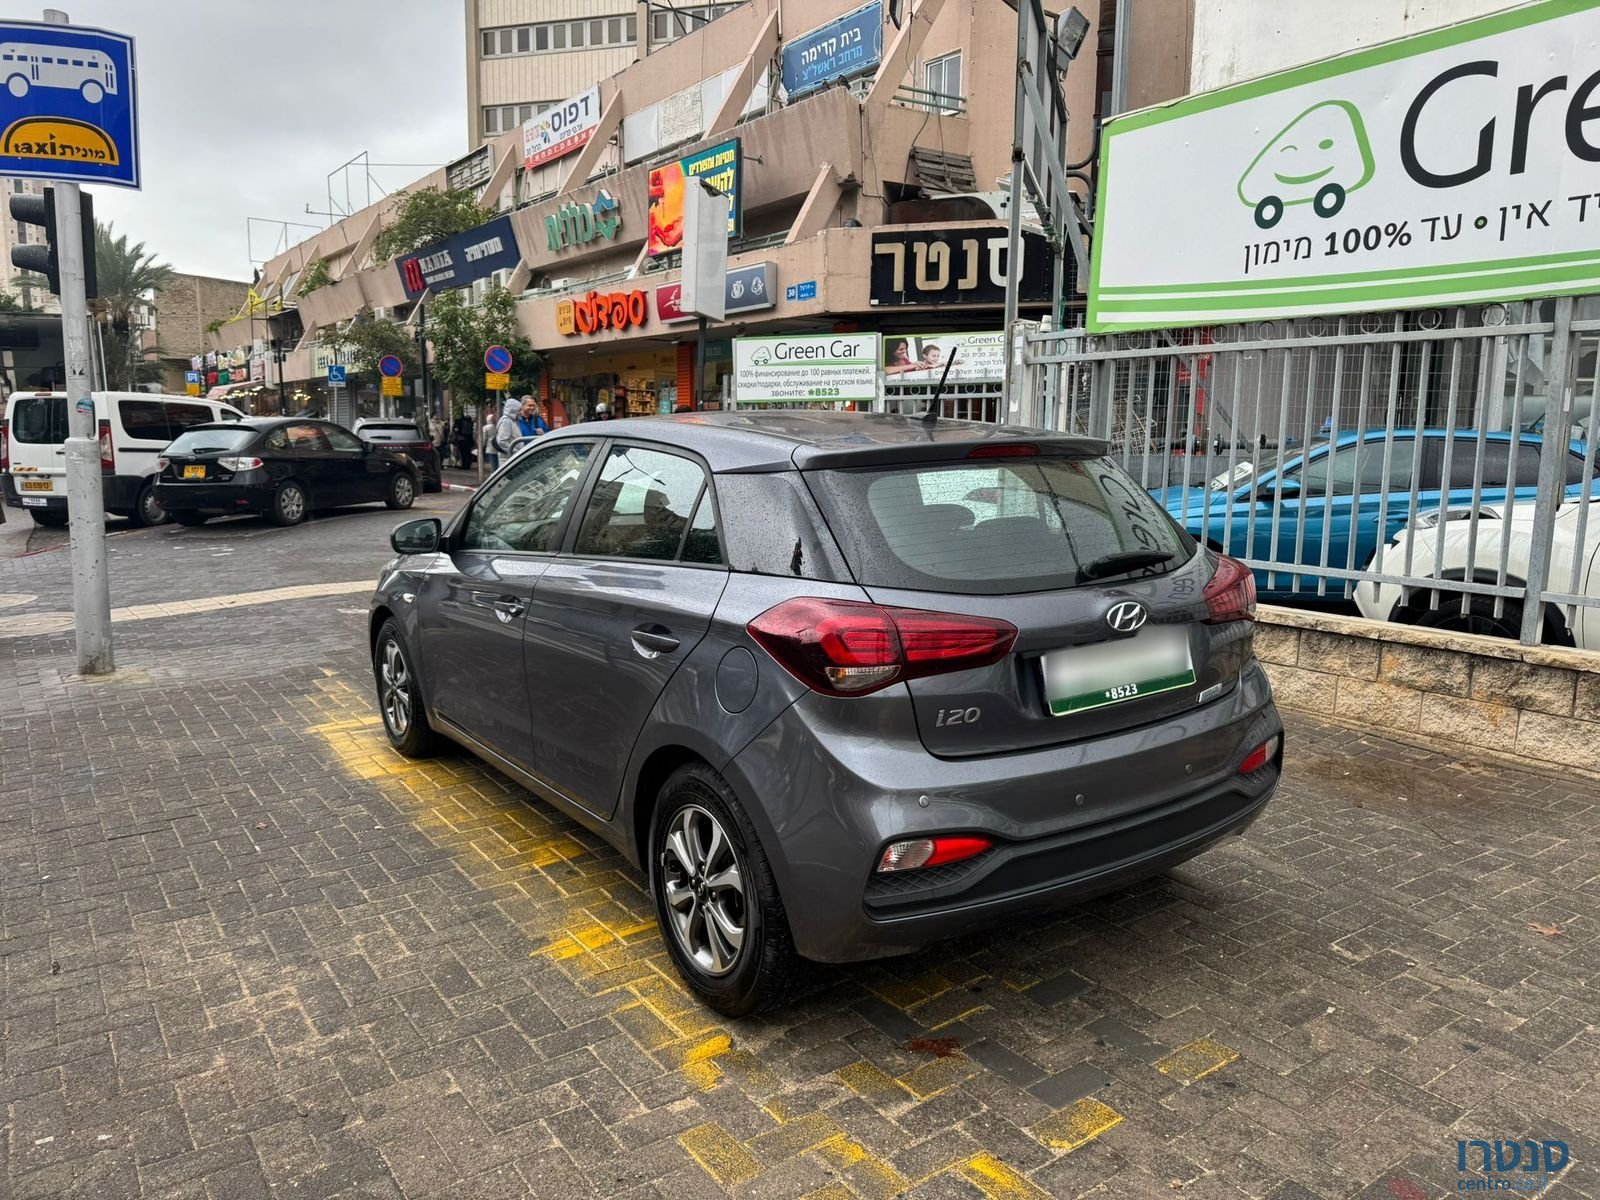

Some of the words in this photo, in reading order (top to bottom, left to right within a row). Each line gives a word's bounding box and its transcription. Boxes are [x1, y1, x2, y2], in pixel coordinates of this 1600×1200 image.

[840, 28, 862, 48] בית
[801, 37, 837, 65] קדימה
[838, 45, 863, 65] מרחב
[551, 95, 589, 132] דפוס
[13, 134, 56, 156] taxi
[59, 143, 106, 160] מונית
[545, 201, 594, 252] כללית
[1420, 213, 1462, 242] עד
[1499, 199, 1553, 241] אין
[1324, 220, 1412, 256] 100%
[874, 237, 1025, 292] סנטר
[1244, 236, 1313, 274] מימון
[774, 342, 825, 360] Green
[830, 340, 860, 358] Car
[967, 336, 996, 345] Green
[740, 369, 754, 378] 100%
[754, 369, 801, 378] финансирование
[801, 369, 809, 377] до
[810, 368, 820, 376] 100
[821, 368, 841, 377] равных
[783, 379, 822, 388] обслуживание
[832, 379, 856, 388] русском
[935, 707, 981, 728] i20
